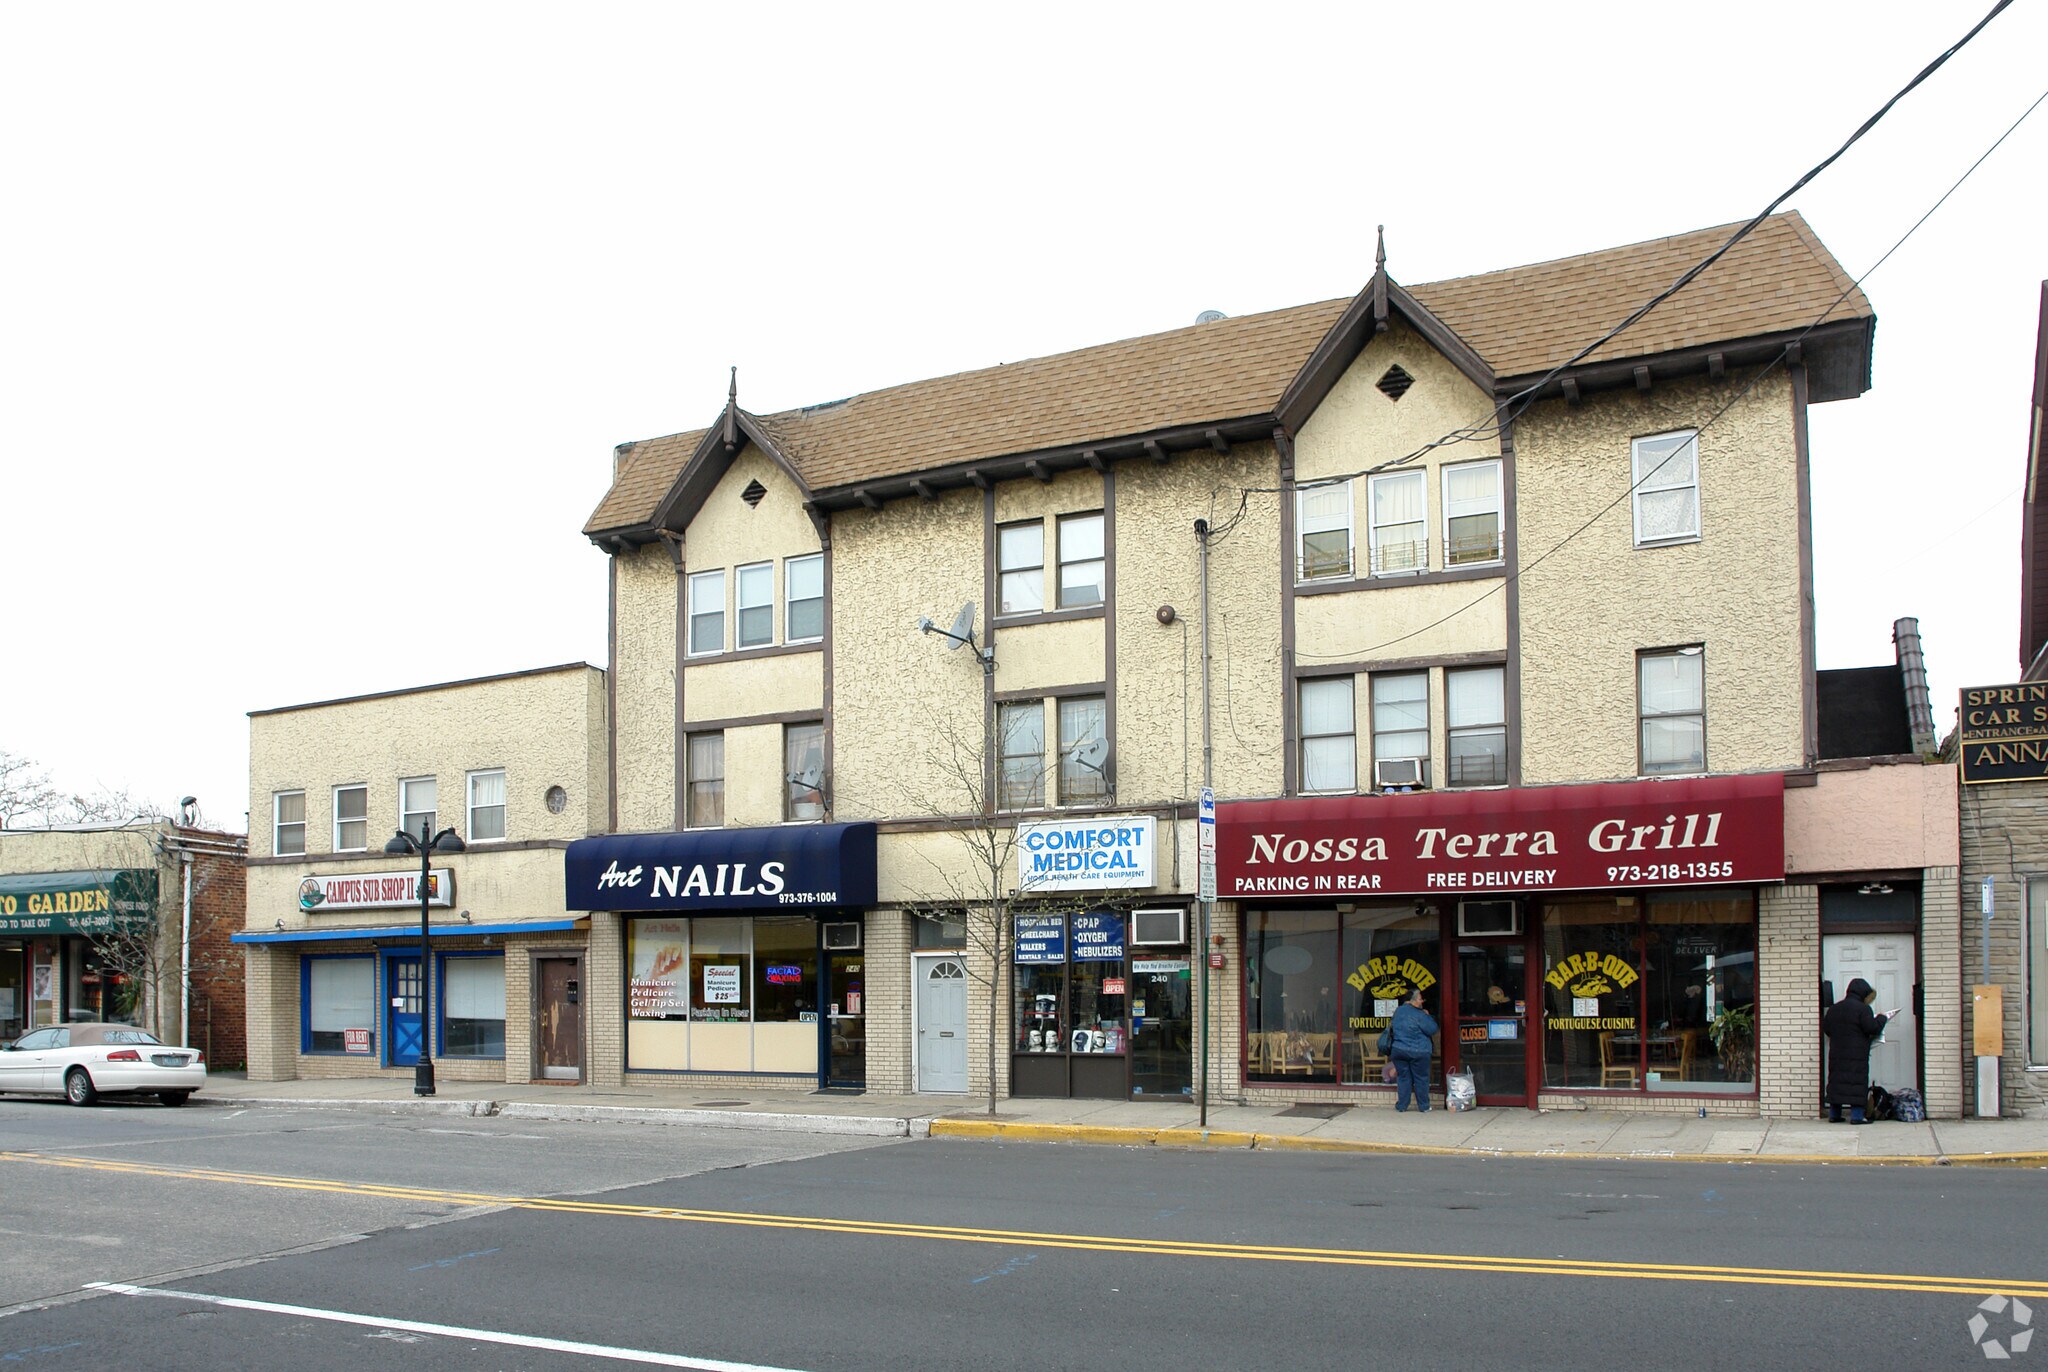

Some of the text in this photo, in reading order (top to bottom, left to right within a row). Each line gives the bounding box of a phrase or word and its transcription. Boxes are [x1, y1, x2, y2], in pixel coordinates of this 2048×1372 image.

[1968, 685, 2047, 706] SPRIN
[1968, 708, 2022, 726] CAR
[1968, 726, 2033, 739] ENTRANCE
[1026, 827, 1145, 851] COMFORT
[1245, 812, 1723, 865] Nossa Terra Grill
[1033, 850, 1138, 872] MEDICAL
[1027, 870, 1145, 882] HOME HEALTH CARE EQUIPMENT
[1607, 861, 1733, 882] 973-218-1355
[597, 860, 786, 898] Art NAILS
[1235, 874, 1382, 892] PARKING IN REAR
[1427, 869, 1557, 888] FREE DELIVERY
[326, 876, 415, 904] CAMPUS SUB SHOP II
[28, 889, 110, 915] GARDEN
[778, 891, 837, 905] 973-376-1004
[10, 918, 19, 929] TO
[20, 918, 36, 928] TAKE
[37, 917, 51, 928] OUT
[1051, 918, 1062, 926] BED
[1077, 917, 1100, 929] CPAP
[1020, 930, 1059, 939] WHEELCHAIRS
[1077, 932, 1107, 943] OXYGEN
[1020, 943, 1046, 951] WALKERS
[1077, 946, 1123, 958] NEBULIZERS
[1675, 946, 1718, 954] DELIVER
[707, 967, 737, 978] Special
[767, 967, 797, 976] FACIAL
[1346, 955, 1437, 992] BAR-B-QUE
[1545, 951, 1640, 991] BAR-B-QUE
[630, 978, 677, 987] Manicure
[770, 974, 801, 983] WAXING
[1151, 975, 1168, 983] 240
[630, 988, 674, 997] Pedicure
[630, 998, 685, 1009] Gel/Tip Set
[631, 1008, 667, 1019] Waxing
[801, 1012, 817, 1021] OPEN
[1548, 1017, 1636, 1030] PORTUGUESE CUISINE
[346, 1030, 368, 1043] FOR RENT
[1460, 1027, 1487, 1041] CLOSED
